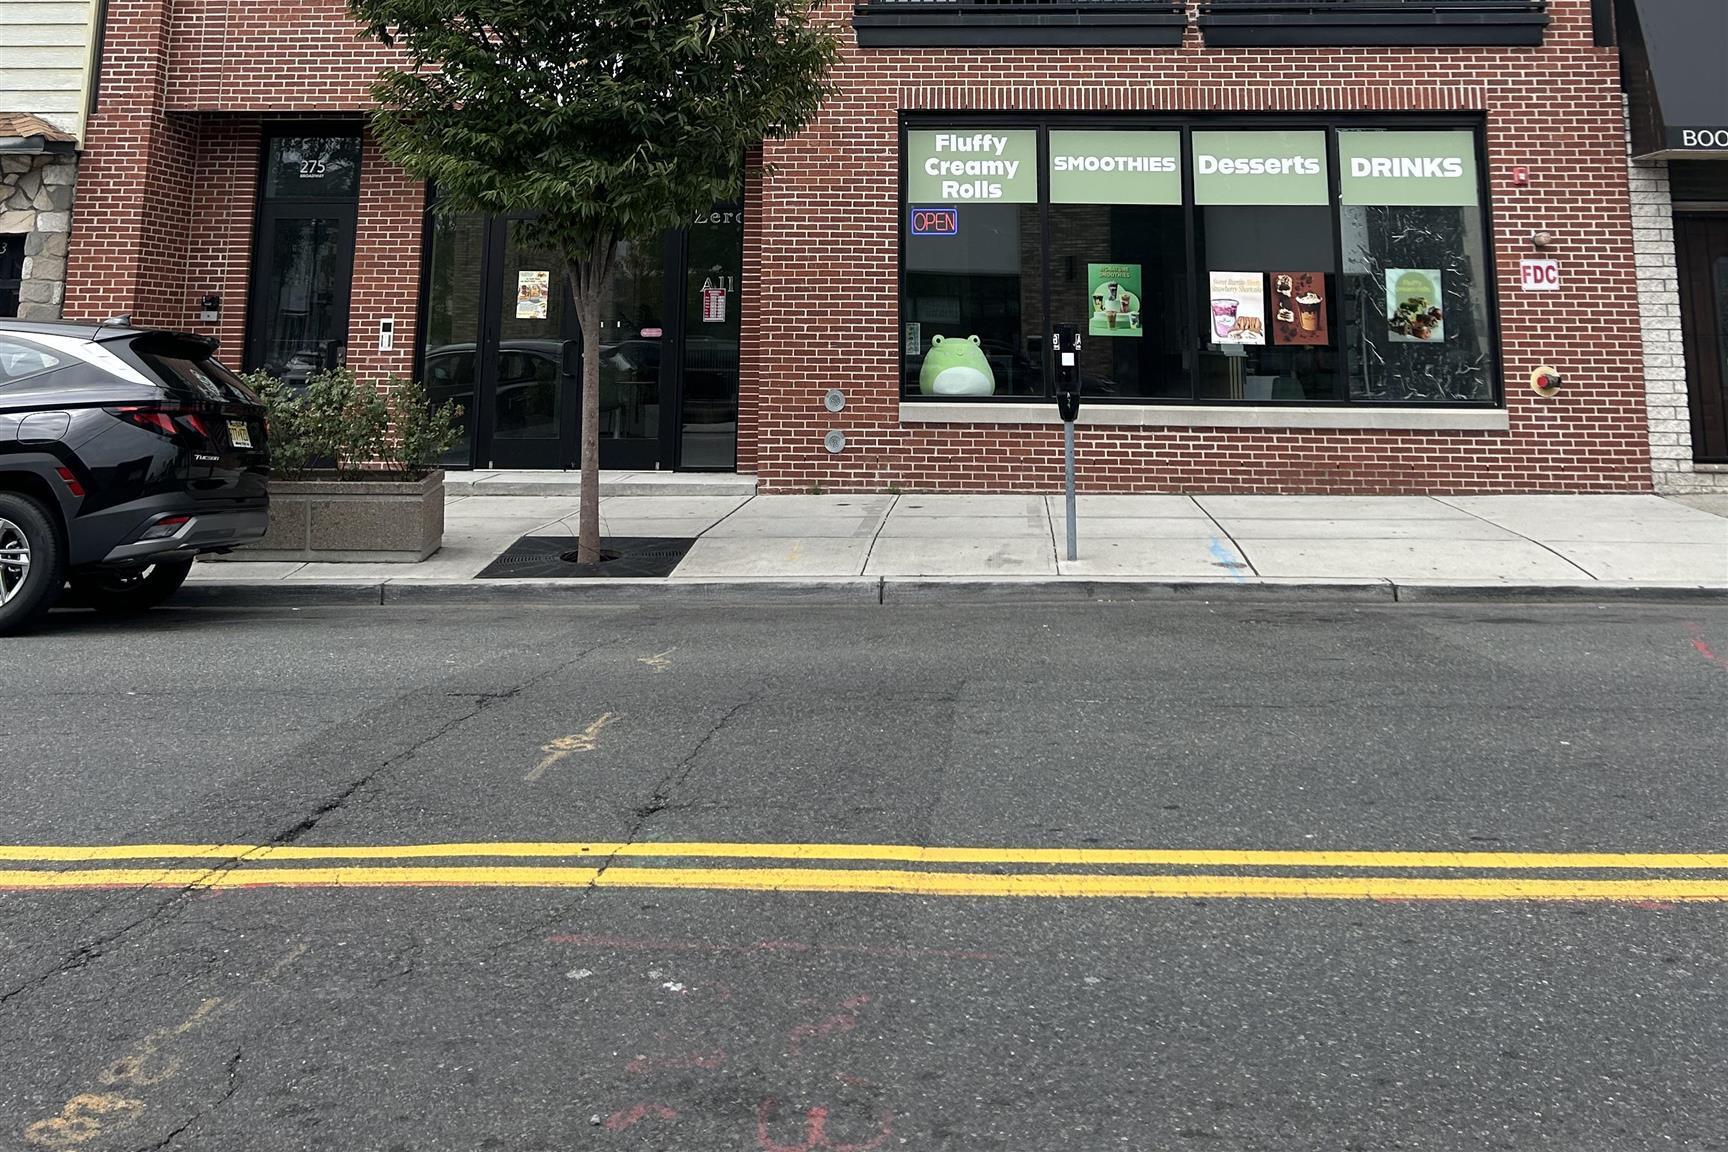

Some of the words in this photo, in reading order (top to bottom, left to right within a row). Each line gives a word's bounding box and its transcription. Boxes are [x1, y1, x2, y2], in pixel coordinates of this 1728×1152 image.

[935, 134, 1007, 156] Fluffy
[300, 160, 326, 173] 275
[924, 157, 1020, 179] Creamy
[1054, 156, 1176, 172] SMOOTHIES
[1198, 155, 1320, 175] Desserts
[1350, 157, 1463, 177] DRINKS
[942, 180, 1003, 199] Rolls
[913, 212, 955, 231] OPEN
[1522, 265, 1557, 284] FDC
